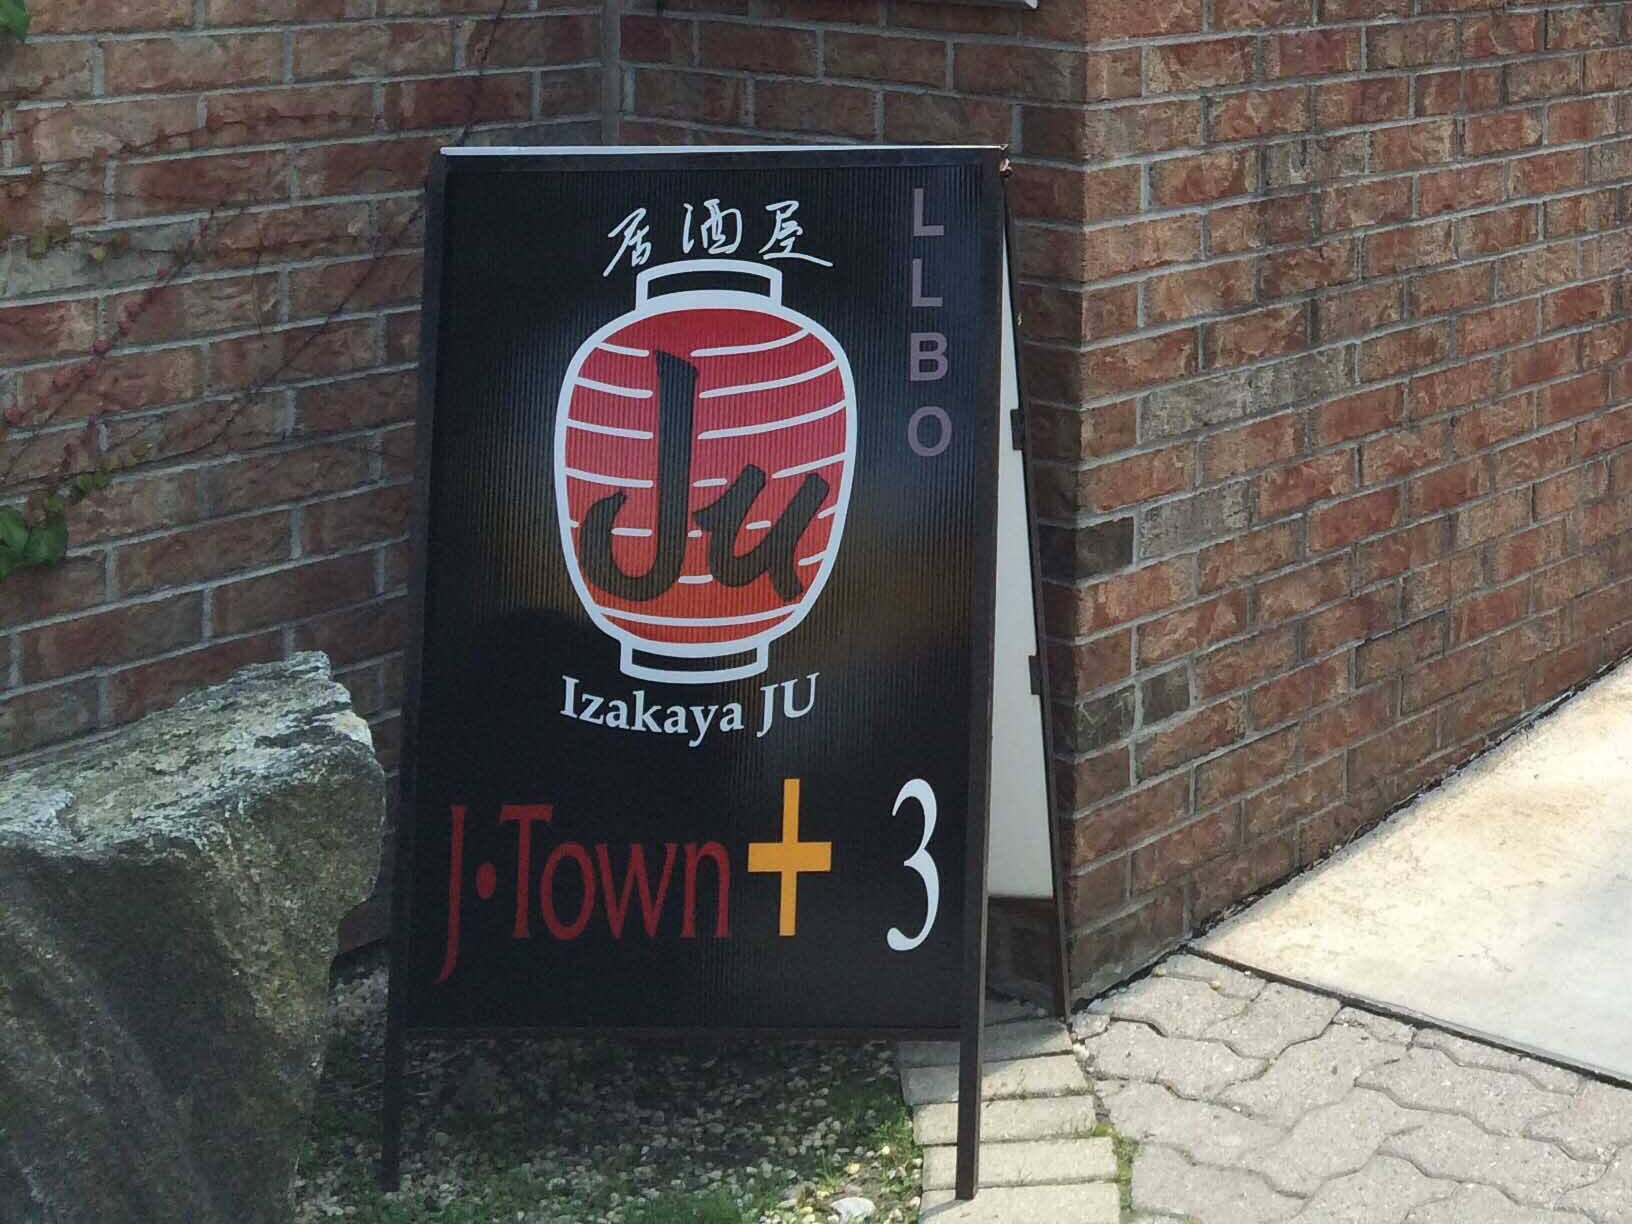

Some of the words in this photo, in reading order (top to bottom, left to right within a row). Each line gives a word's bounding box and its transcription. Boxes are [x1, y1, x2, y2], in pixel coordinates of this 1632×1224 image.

[602, 198, 834, 277] 居酒屋
[907, 187, 953, 457] LLBO
[560, 675, 745, 748] Izakaya
[756, 672, 820, 737] JU
[886, 778, 940, 951] 3
